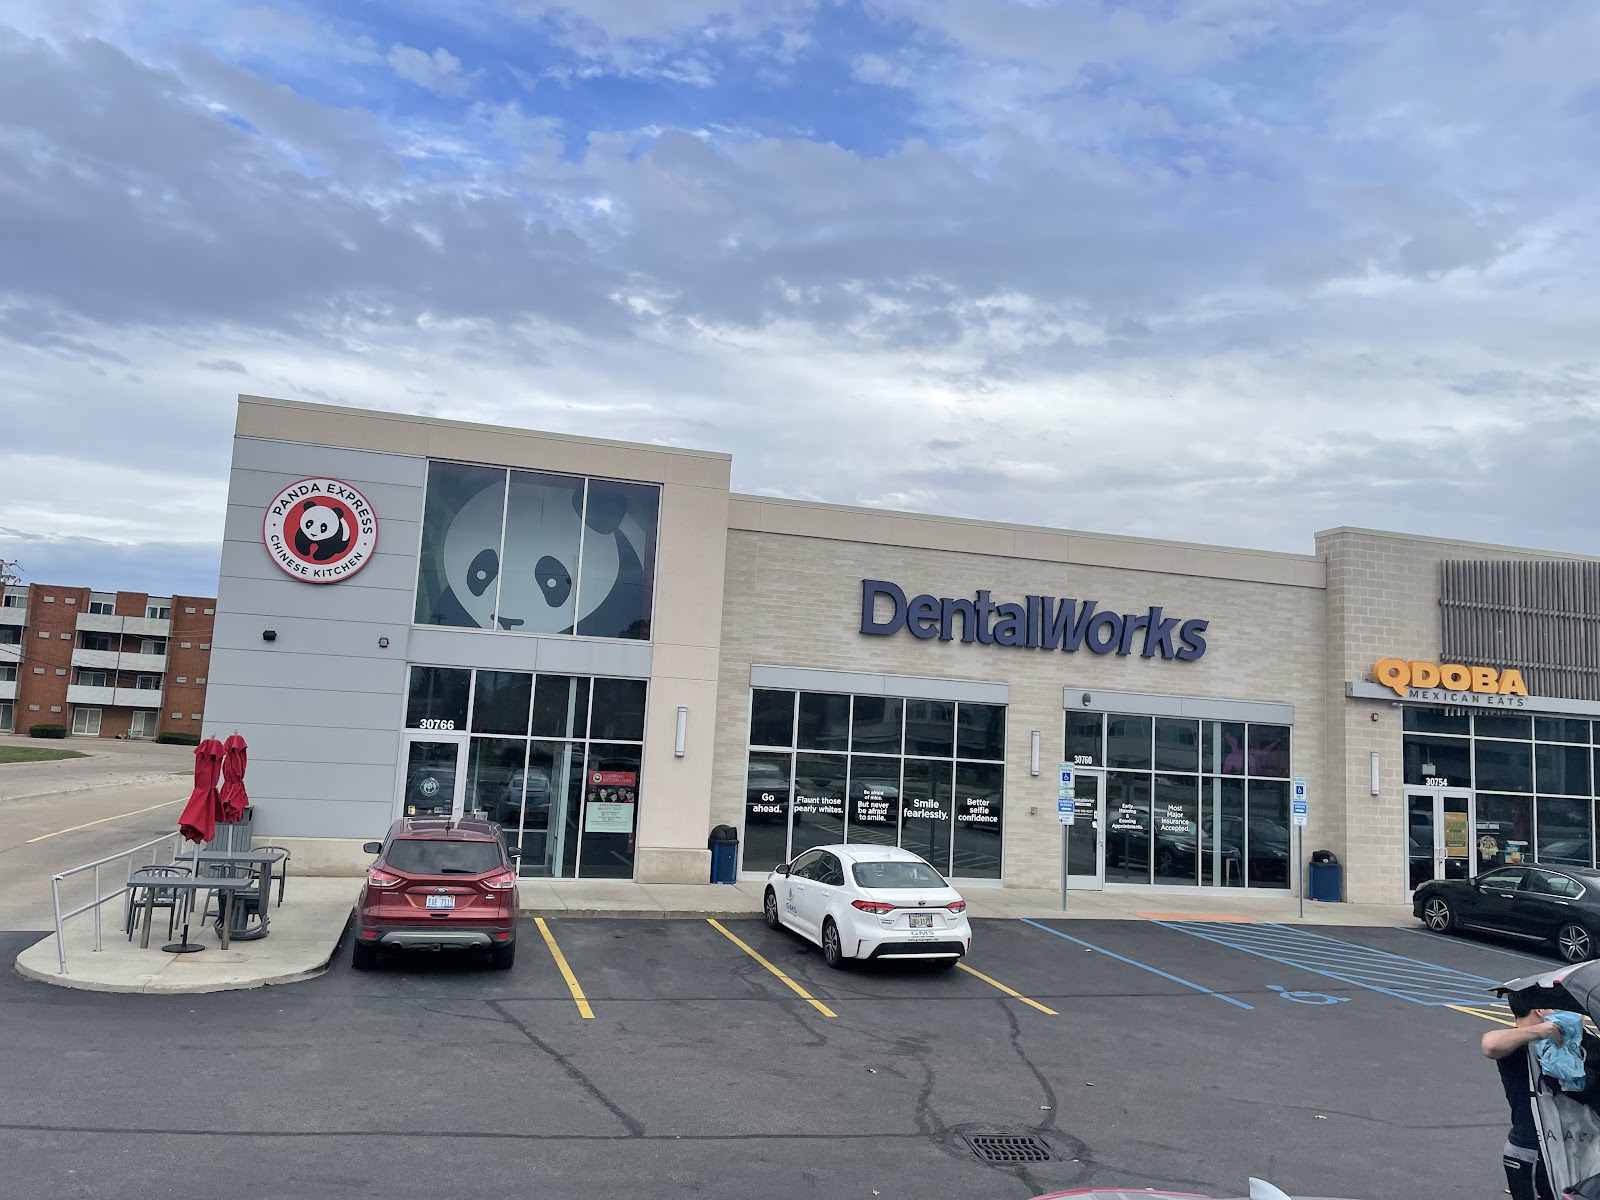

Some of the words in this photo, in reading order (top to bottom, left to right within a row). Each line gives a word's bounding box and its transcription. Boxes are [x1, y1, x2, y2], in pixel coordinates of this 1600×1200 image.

[272, 483, 321, 516] PANDA
[326, 483, 373, 534] EXPRESS
[270, 535, 309, 575] CHINESE
[313, 552, 363, 577] KITCHEN
[859, 578, 1209, 661] DentalWorks
[1373, 657, 1529, 698] QDOBA
[1409, 690, 1480, 703] MEXICAN
[1487, 696, 1524, 707] EATS
[419, 718, 455, 730] 30766
[1073, 755, 1093, 765] 30760
[1425, 777, 1448, 787] 30754
[761, 793, 775, 802] Go
[796, 796, 820, 804] Flaunt
[821, 797, 841, 805] those
[966, 798, 990, 807] Better
[752, 804, 782, 813] ahead.
[913, 799, 940, 809] Smile
[1168, 804, 1183, 812] Most
[793, 805, 817, 814] pearly
[819, 806, 844, 814] whites.
[903, 808, 949, 820] fearlessly.
[957, 814, 998, 823] confidence
[1166, 811, 1184, 819] Major
[1160, 824, 1191, 832] Accepted.
